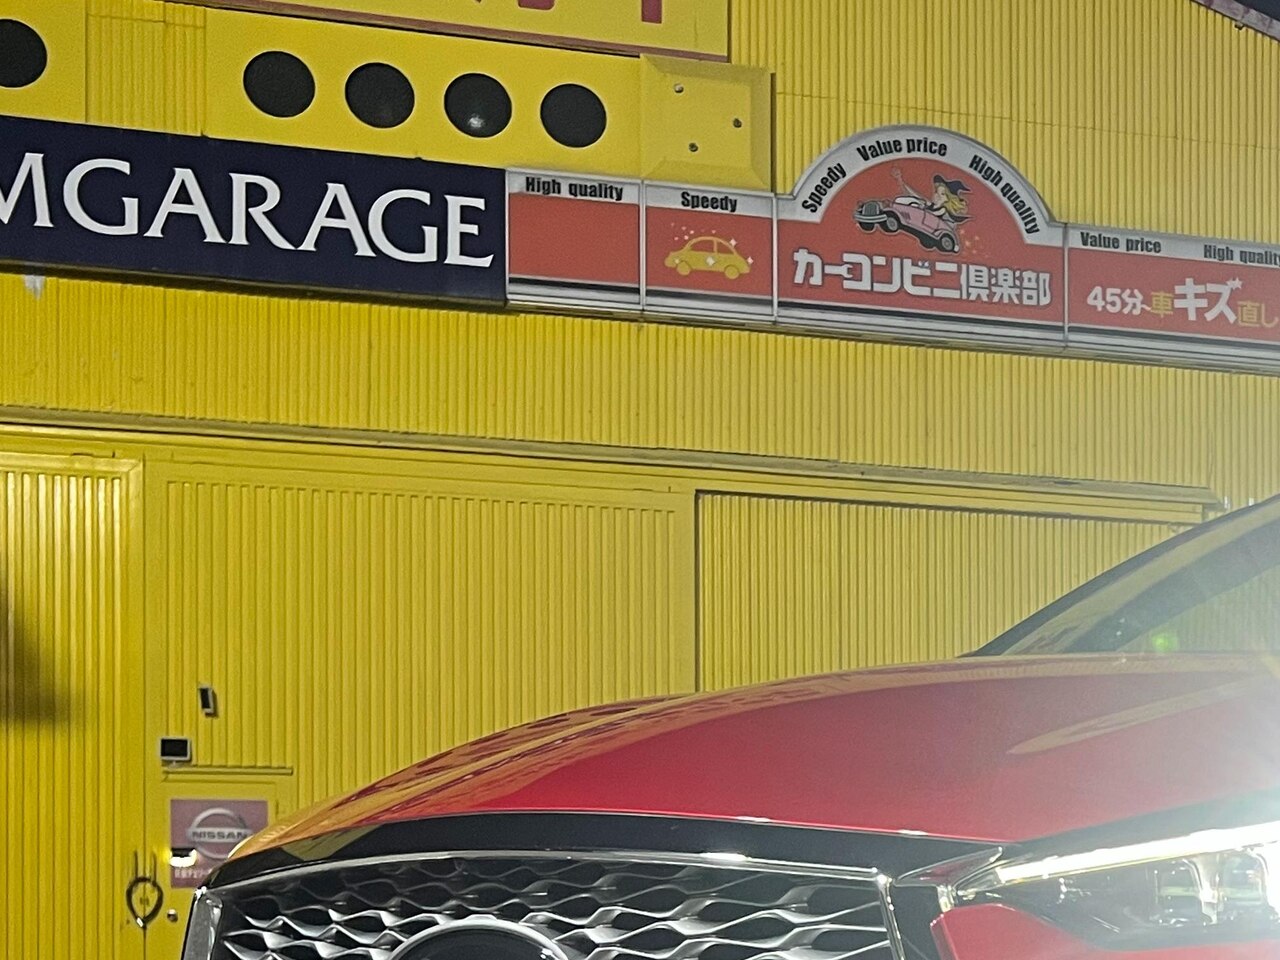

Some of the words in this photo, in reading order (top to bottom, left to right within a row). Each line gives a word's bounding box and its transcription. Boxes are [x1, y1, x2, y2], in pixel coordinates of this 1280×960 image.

[857, 140, 902, 162] Value
[906, 137, 947, 157] price
[525, 176, 561, 195] High
[568, 182, 623, 201] quality
[801, 162, 847, 213] Speedy
[968, 154, 1002, 187] High
[1000, 182, 1040, 235] quality
[681, 191, 737, 212] Speedy
[1080, 231, 1119, 249] Value
[1126, 237, 1161, 254] price
[1203, 244, 1234, 261] High
[793, 248, 1051, 306] カーコンビニ倶楽部
[192, 831, 247, 840] NISSAN
